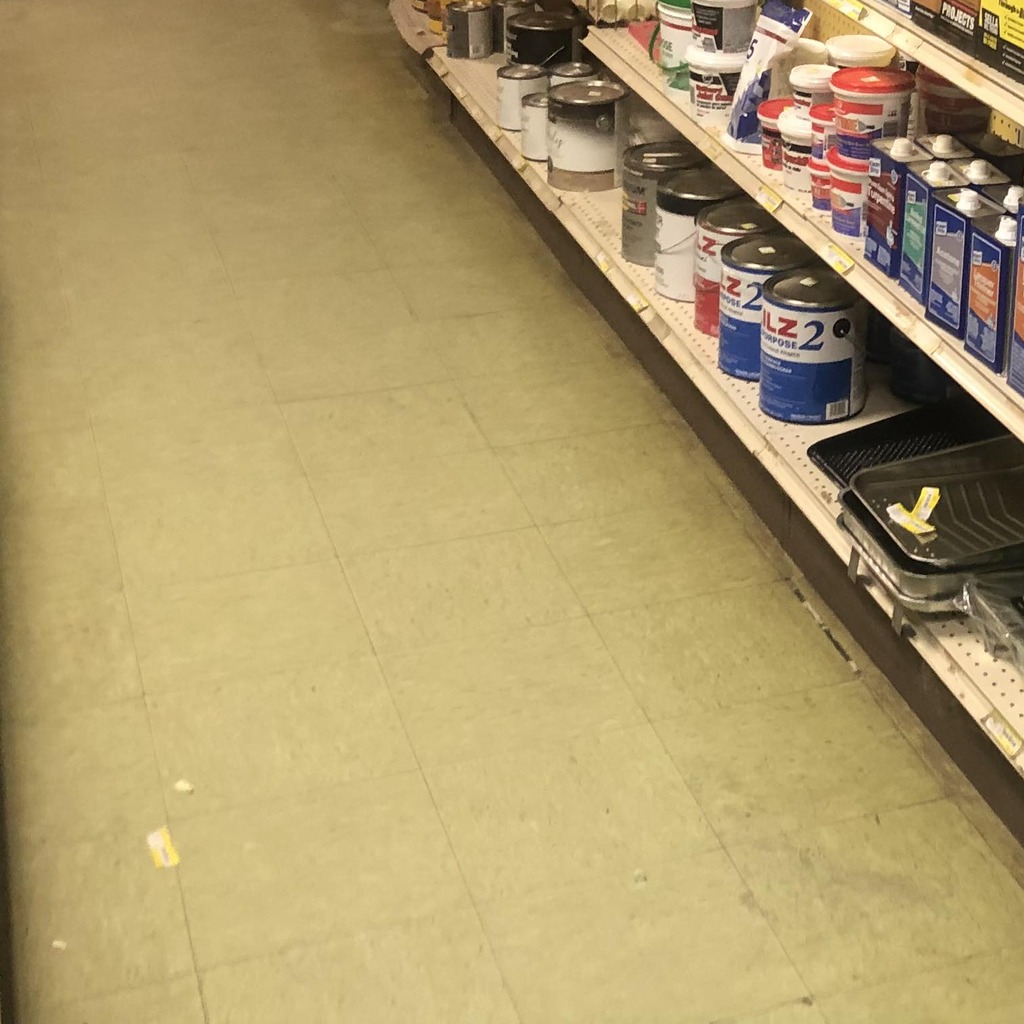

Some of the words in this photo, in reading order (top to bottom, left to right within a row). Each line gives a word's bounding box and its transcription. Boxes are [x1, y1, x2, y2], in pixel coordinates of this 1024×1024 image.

[941, 1, 976, 31] PROJECTS
[742, 281, 763, 311] 2
[763, 308, 798, 339] ILZ
[798, 320, 825, 351] 2
